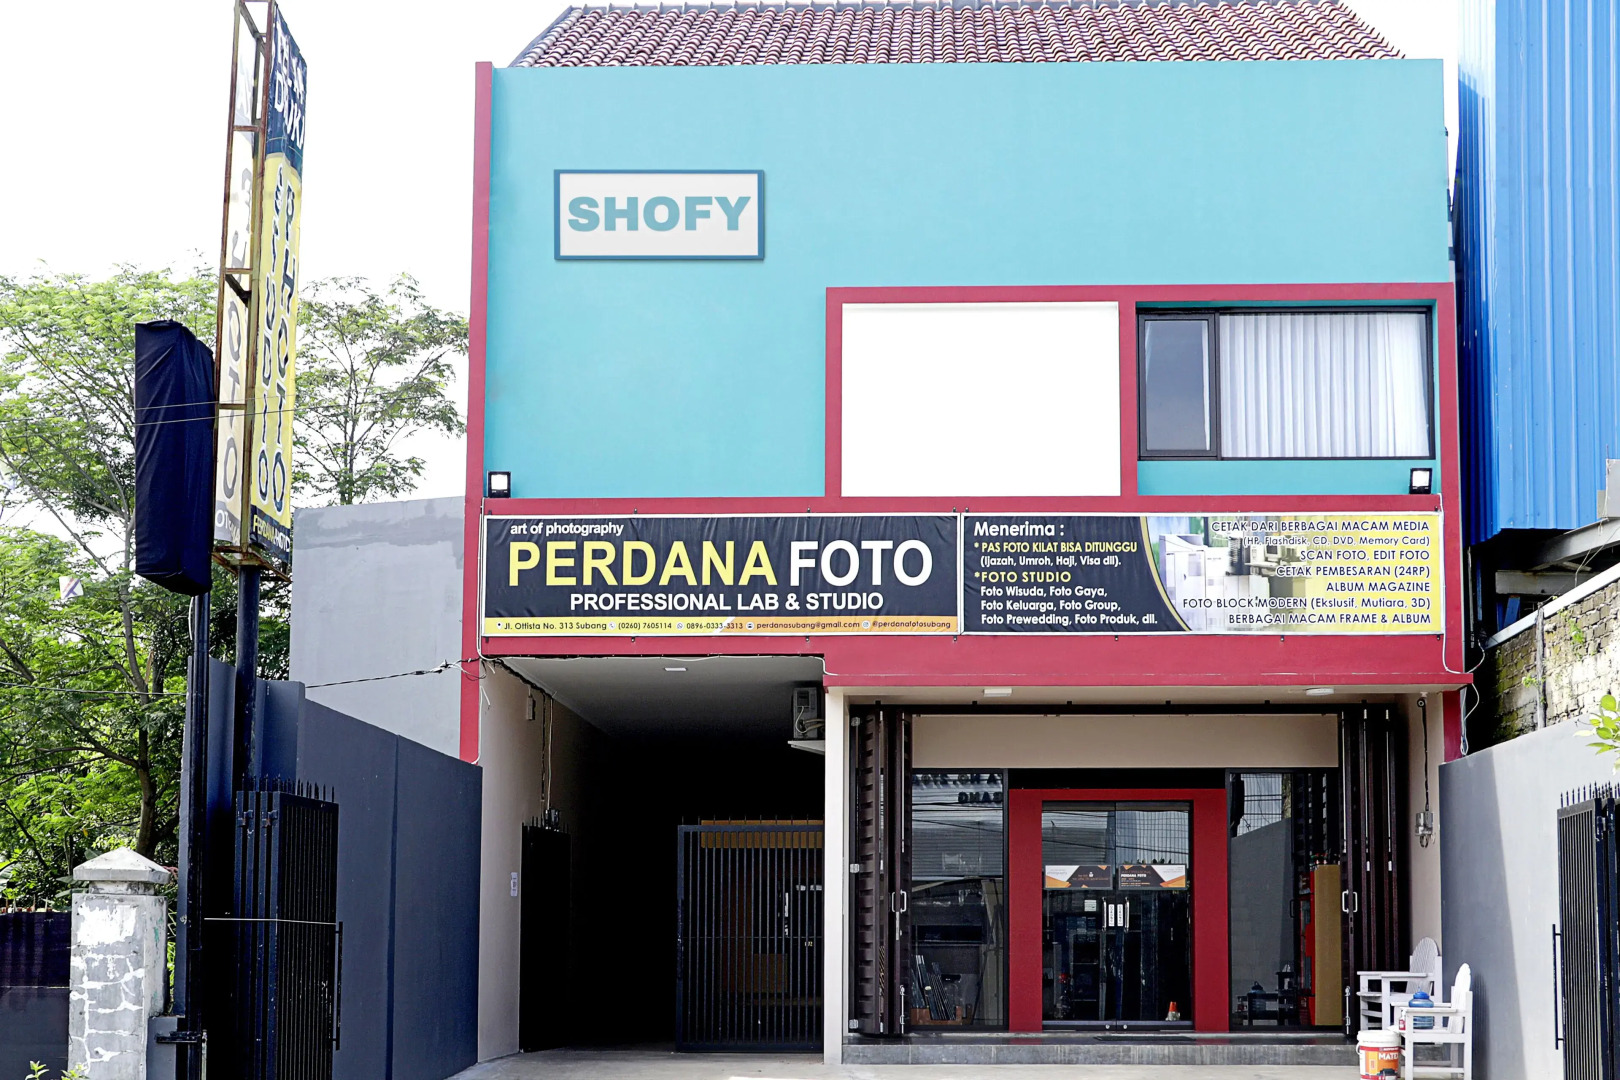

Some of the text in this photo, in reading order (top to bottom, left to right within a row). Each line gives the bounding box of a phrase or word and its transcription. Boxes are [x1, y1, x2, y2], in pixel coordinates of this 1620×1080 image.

[568, 196, 751, 232] SHOFY
[510, 522, 624, 538] art of photography
[974, 521, 1065, 536] Menerima :
[1212, 521, 1429, 531] CETAK DARI BERBAGAI MACAM MEDIA
[1265, 537, 1309, 546] Flashdisk,
[1313, 537, 1330, 545] CD,
[1333, 537, 1356, 545] DVD,
[1359, 537, 1399, 546] Memory
[1402, 536, 1430, 546] Card)
[982, 542, 1137, 552] PAS FOTO KILAT BISA DITUNGGU
[1301, 550, 1430, 561] SCAN FOTO, EDIT FOTO
[509, 540, 933, 586] PERDANA FOTO
[1019, 556, 1054, 566] Umroh,
[1056, 556, 1077, 567] Haji,
[1080, 556, 1100, 565] Visa
[1103, 556, 1121, 567] dll).
[1022, 572, 1071, 582] STUDIO
[1276, 566, 1430, 578] CETAK PEMBESARAN (24RP)
[981, 586, 1107, 598] Foto Wisuda, Foto Gaya,
[1326, 582, 1430, 592] ALBUM MAGAZINE
[570, 592, 883, 610] PROFESSIONAL LAB & STUDIO
[981, 600, 1121, 612] Foto Keluarga, Foto Group,
[1183, 598, 1213, 608] FOTO
[1258, 598, 1307, 608] MODERN
[1311, 597, 1357, 609] (Ekslusif,
[1361, 597, 1408, 609] Mutiara,
[1411, 597, 1430, 609] 3D)
[872, 620, 951, 629] @perdanafotosubang
[982, 614, 1157, 626] Foto Prewedding, Foto Produk, dll.
[1229, 614, 1430, 624] BERBAGAI MACAM FRAME & ALBUM
[576, 622, 606, 631] Subang
[756, 621, 860, 630] perdanasubang@gmail.com
